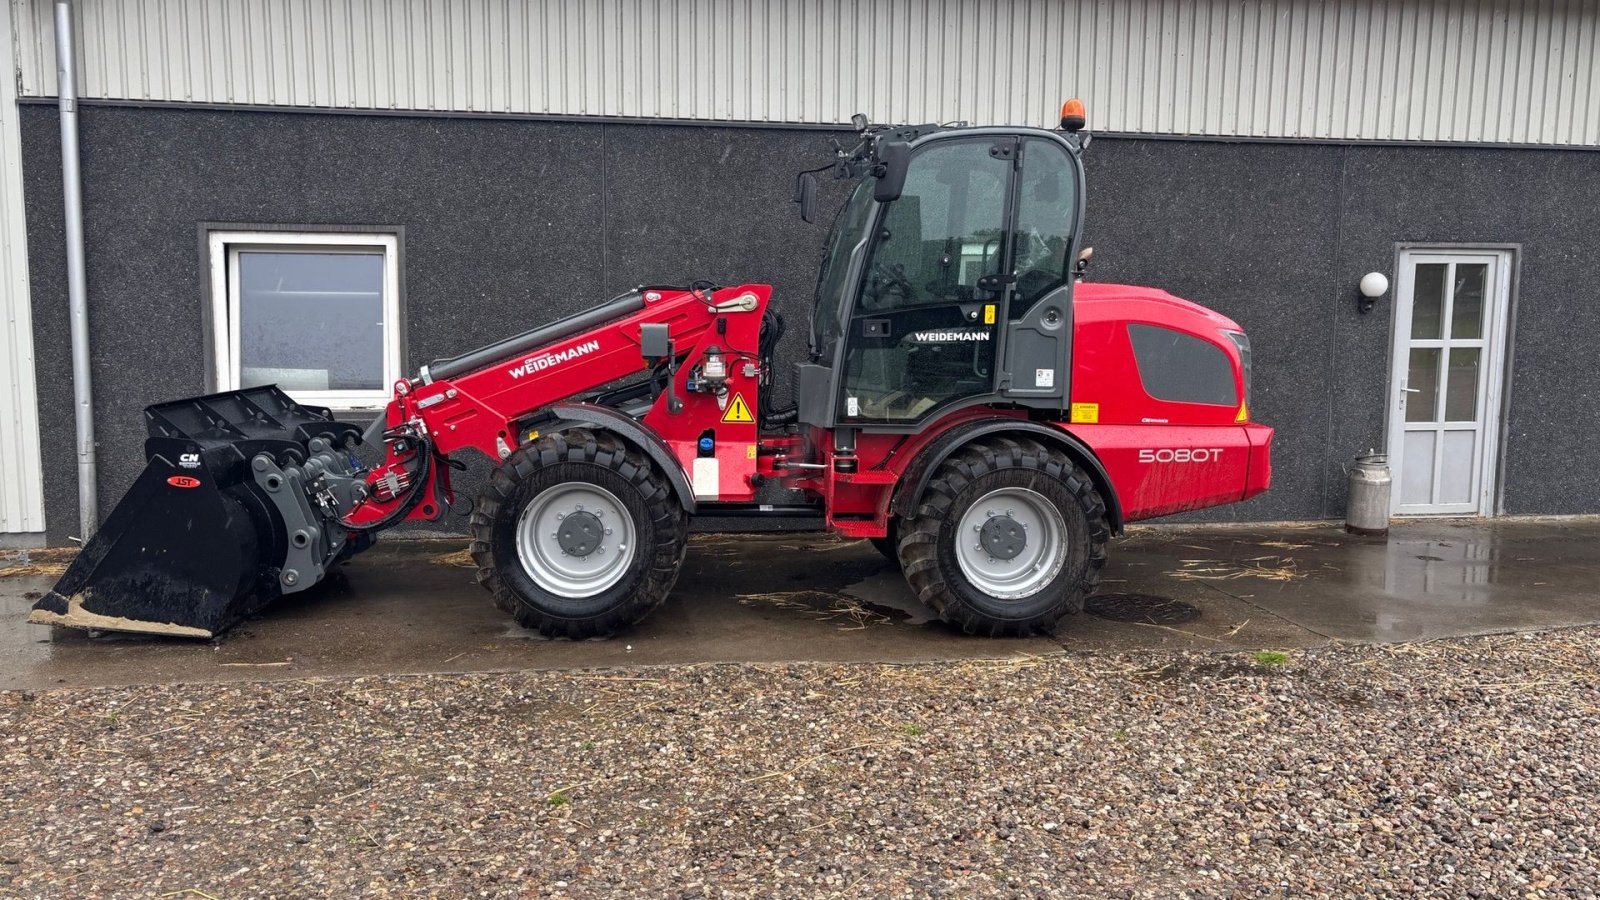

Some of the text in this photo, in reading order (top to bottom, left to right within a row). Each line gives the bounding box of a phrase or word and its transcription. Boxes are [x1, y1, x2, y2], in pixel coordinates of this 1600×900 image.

[915, 332, 989, 341] WEIDEMANN
[508, 340, 600, 379] WEIDEMANN
[180, 454, 199, 462] CN
[1139, 449, 1223, 463] 5080T
